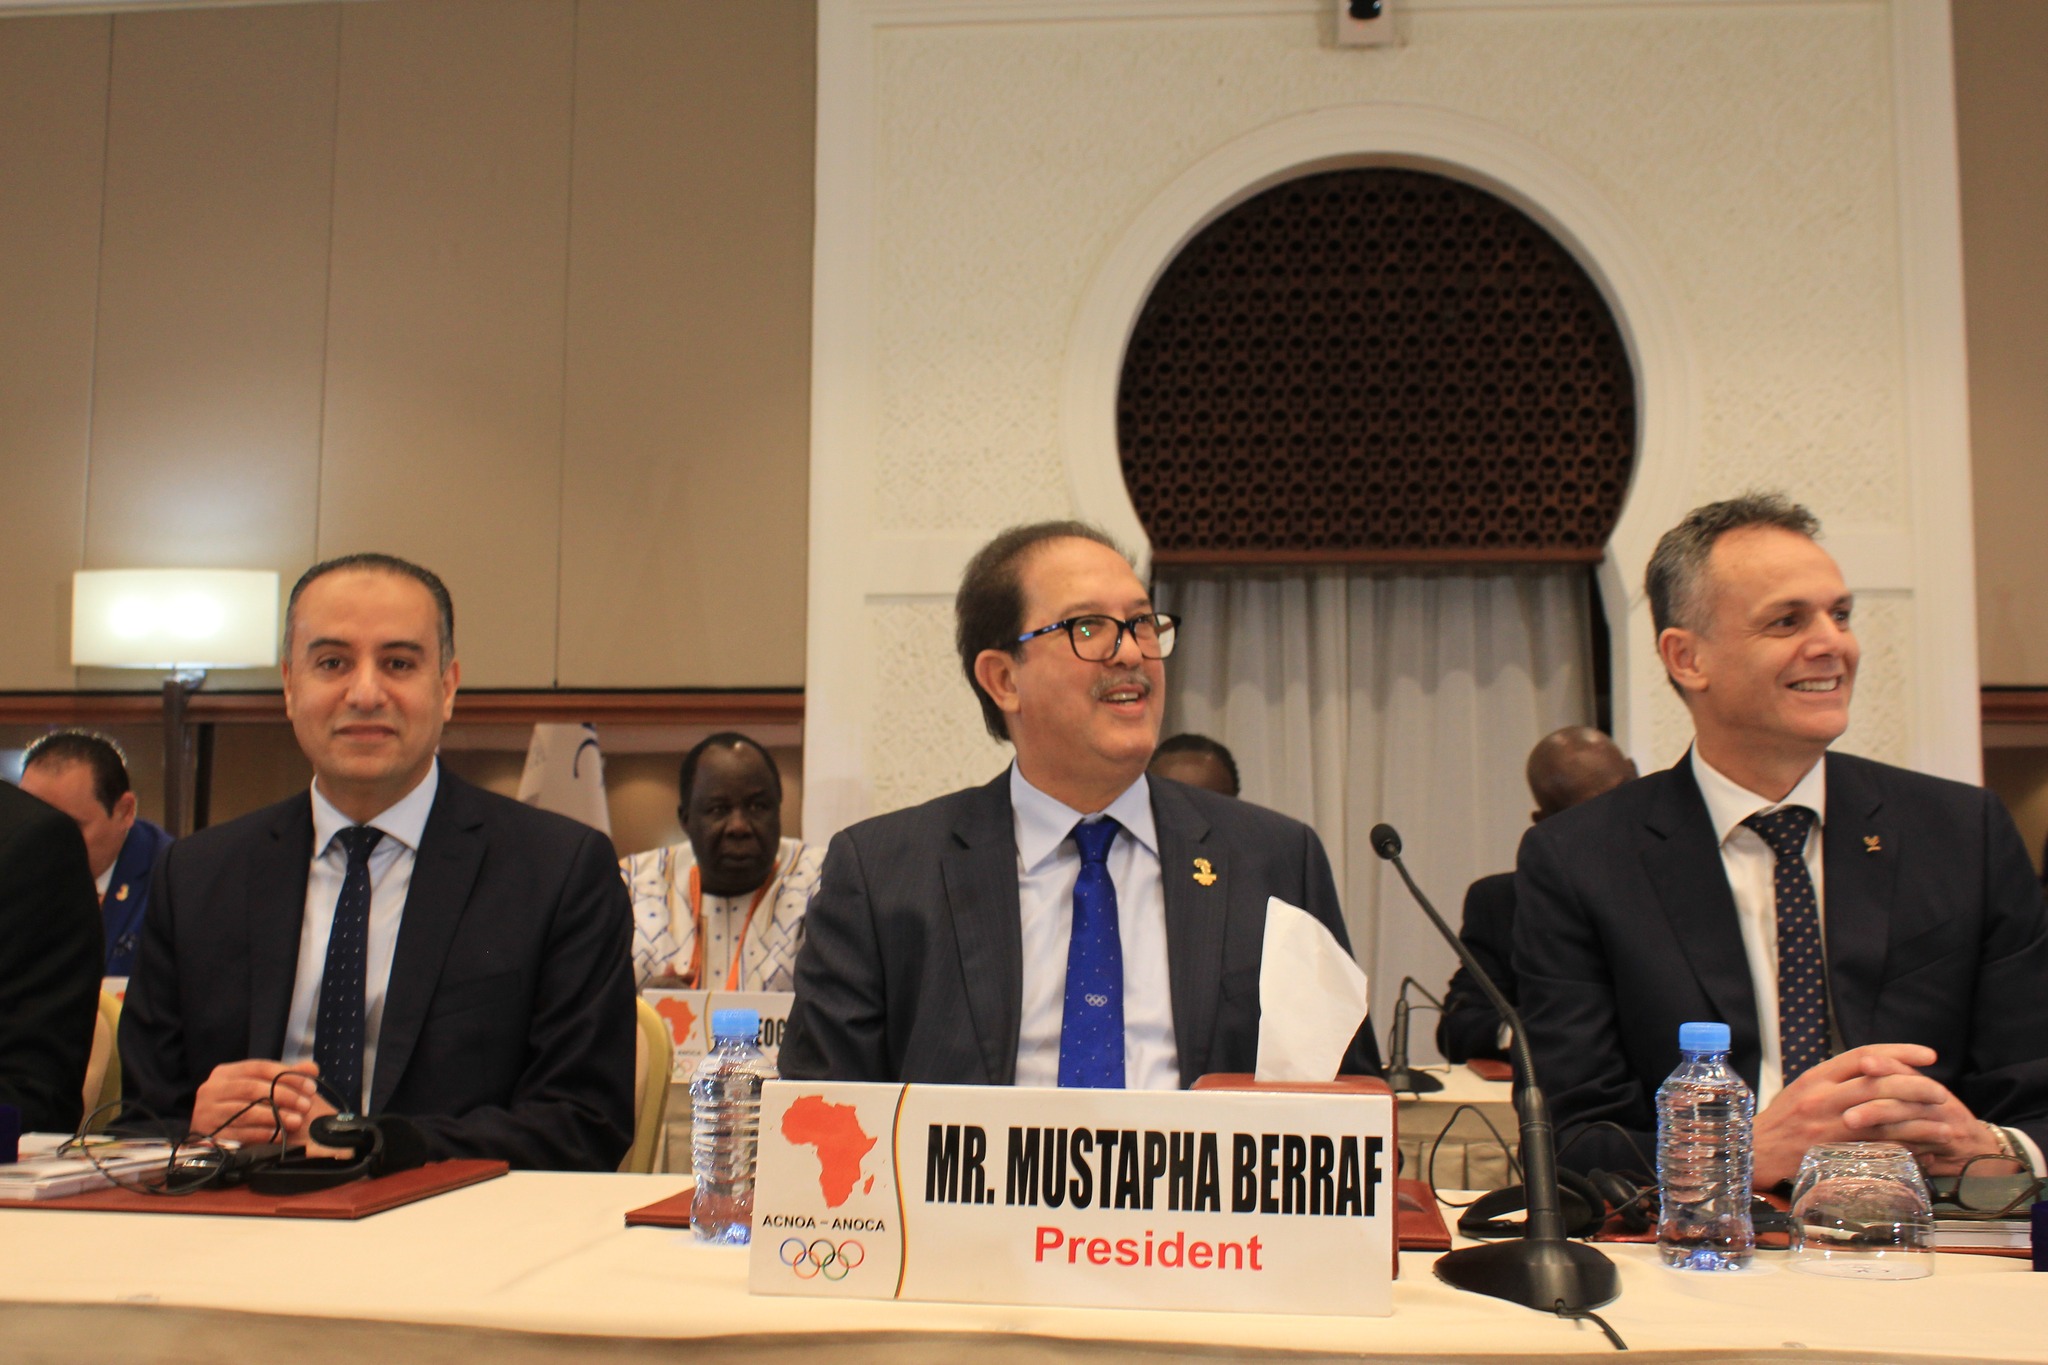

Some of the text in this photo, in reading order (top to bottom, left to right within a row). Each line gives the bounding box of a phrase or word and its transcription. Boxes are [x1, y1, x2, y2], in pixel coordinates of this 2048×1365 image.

[925, 1124, 1383, 1217] MR. MUSTAPHA BERRAF
[762, 1214, 816, 1229] ACNOA
[832, 1217, 886, 1232] ANOCA
[1035, 1226, 1263, 1271] President
